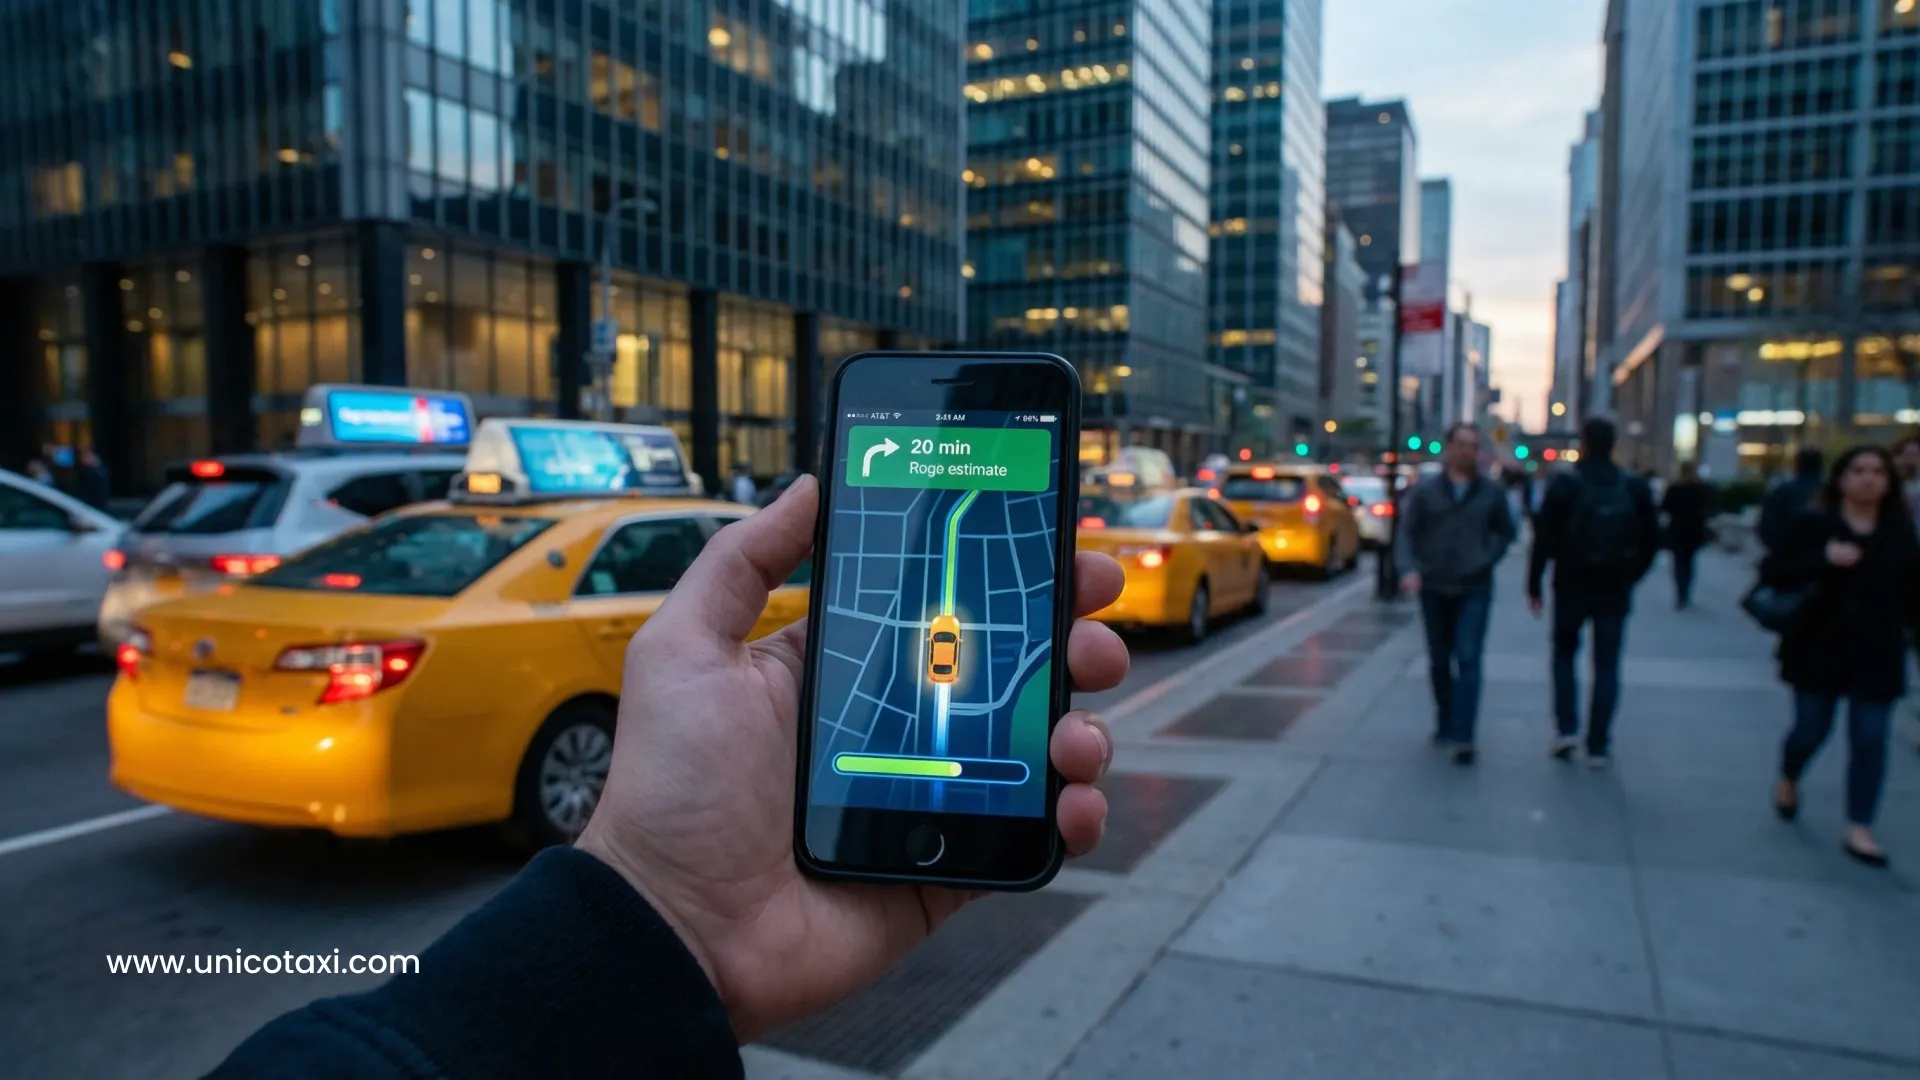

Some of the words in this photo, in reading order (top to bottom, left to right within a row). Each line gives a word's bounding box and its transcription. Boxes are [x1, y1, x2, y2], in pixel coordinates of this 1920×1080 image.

[870, 412, 890, 420] AT&T
[910, 438, 934, 455] 20
[938, 439, 971, 455] min
[909, 461, 945, 478] Roge
[947, 462, 1008, 476] estimate
